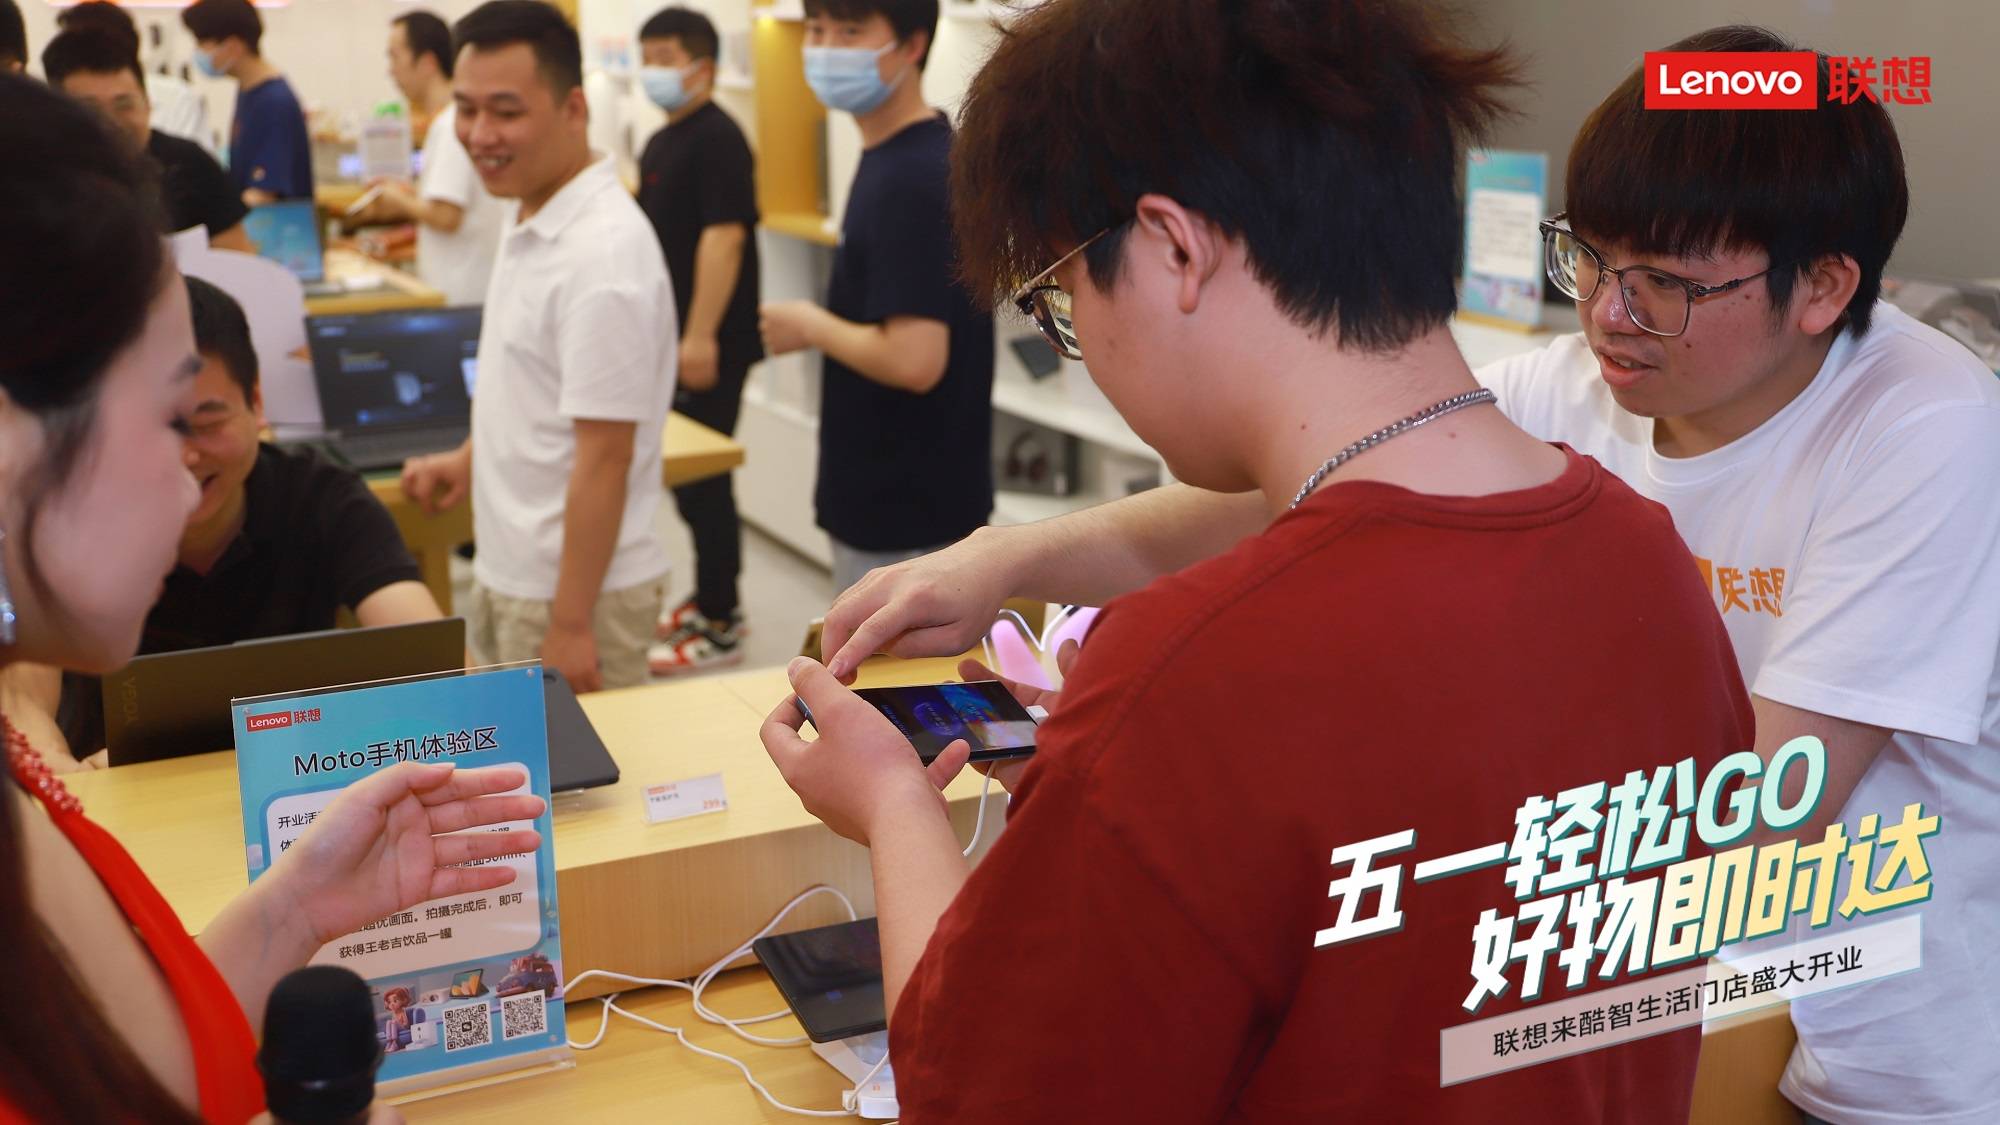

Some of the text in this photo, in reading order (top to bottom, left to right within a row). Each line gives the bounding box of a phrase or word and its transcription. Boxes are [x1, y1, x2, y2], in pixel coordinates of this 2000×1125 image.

[1716, 567, 1786, 618] 联想
[250, 708, 321, 728] Lenovo 联想
[294, 726, 498, 776] Moto手机体验区
[278, 811, 321, 829] 开业活
[339, 927, 453, 959] 获得王老吉饮品一罐
